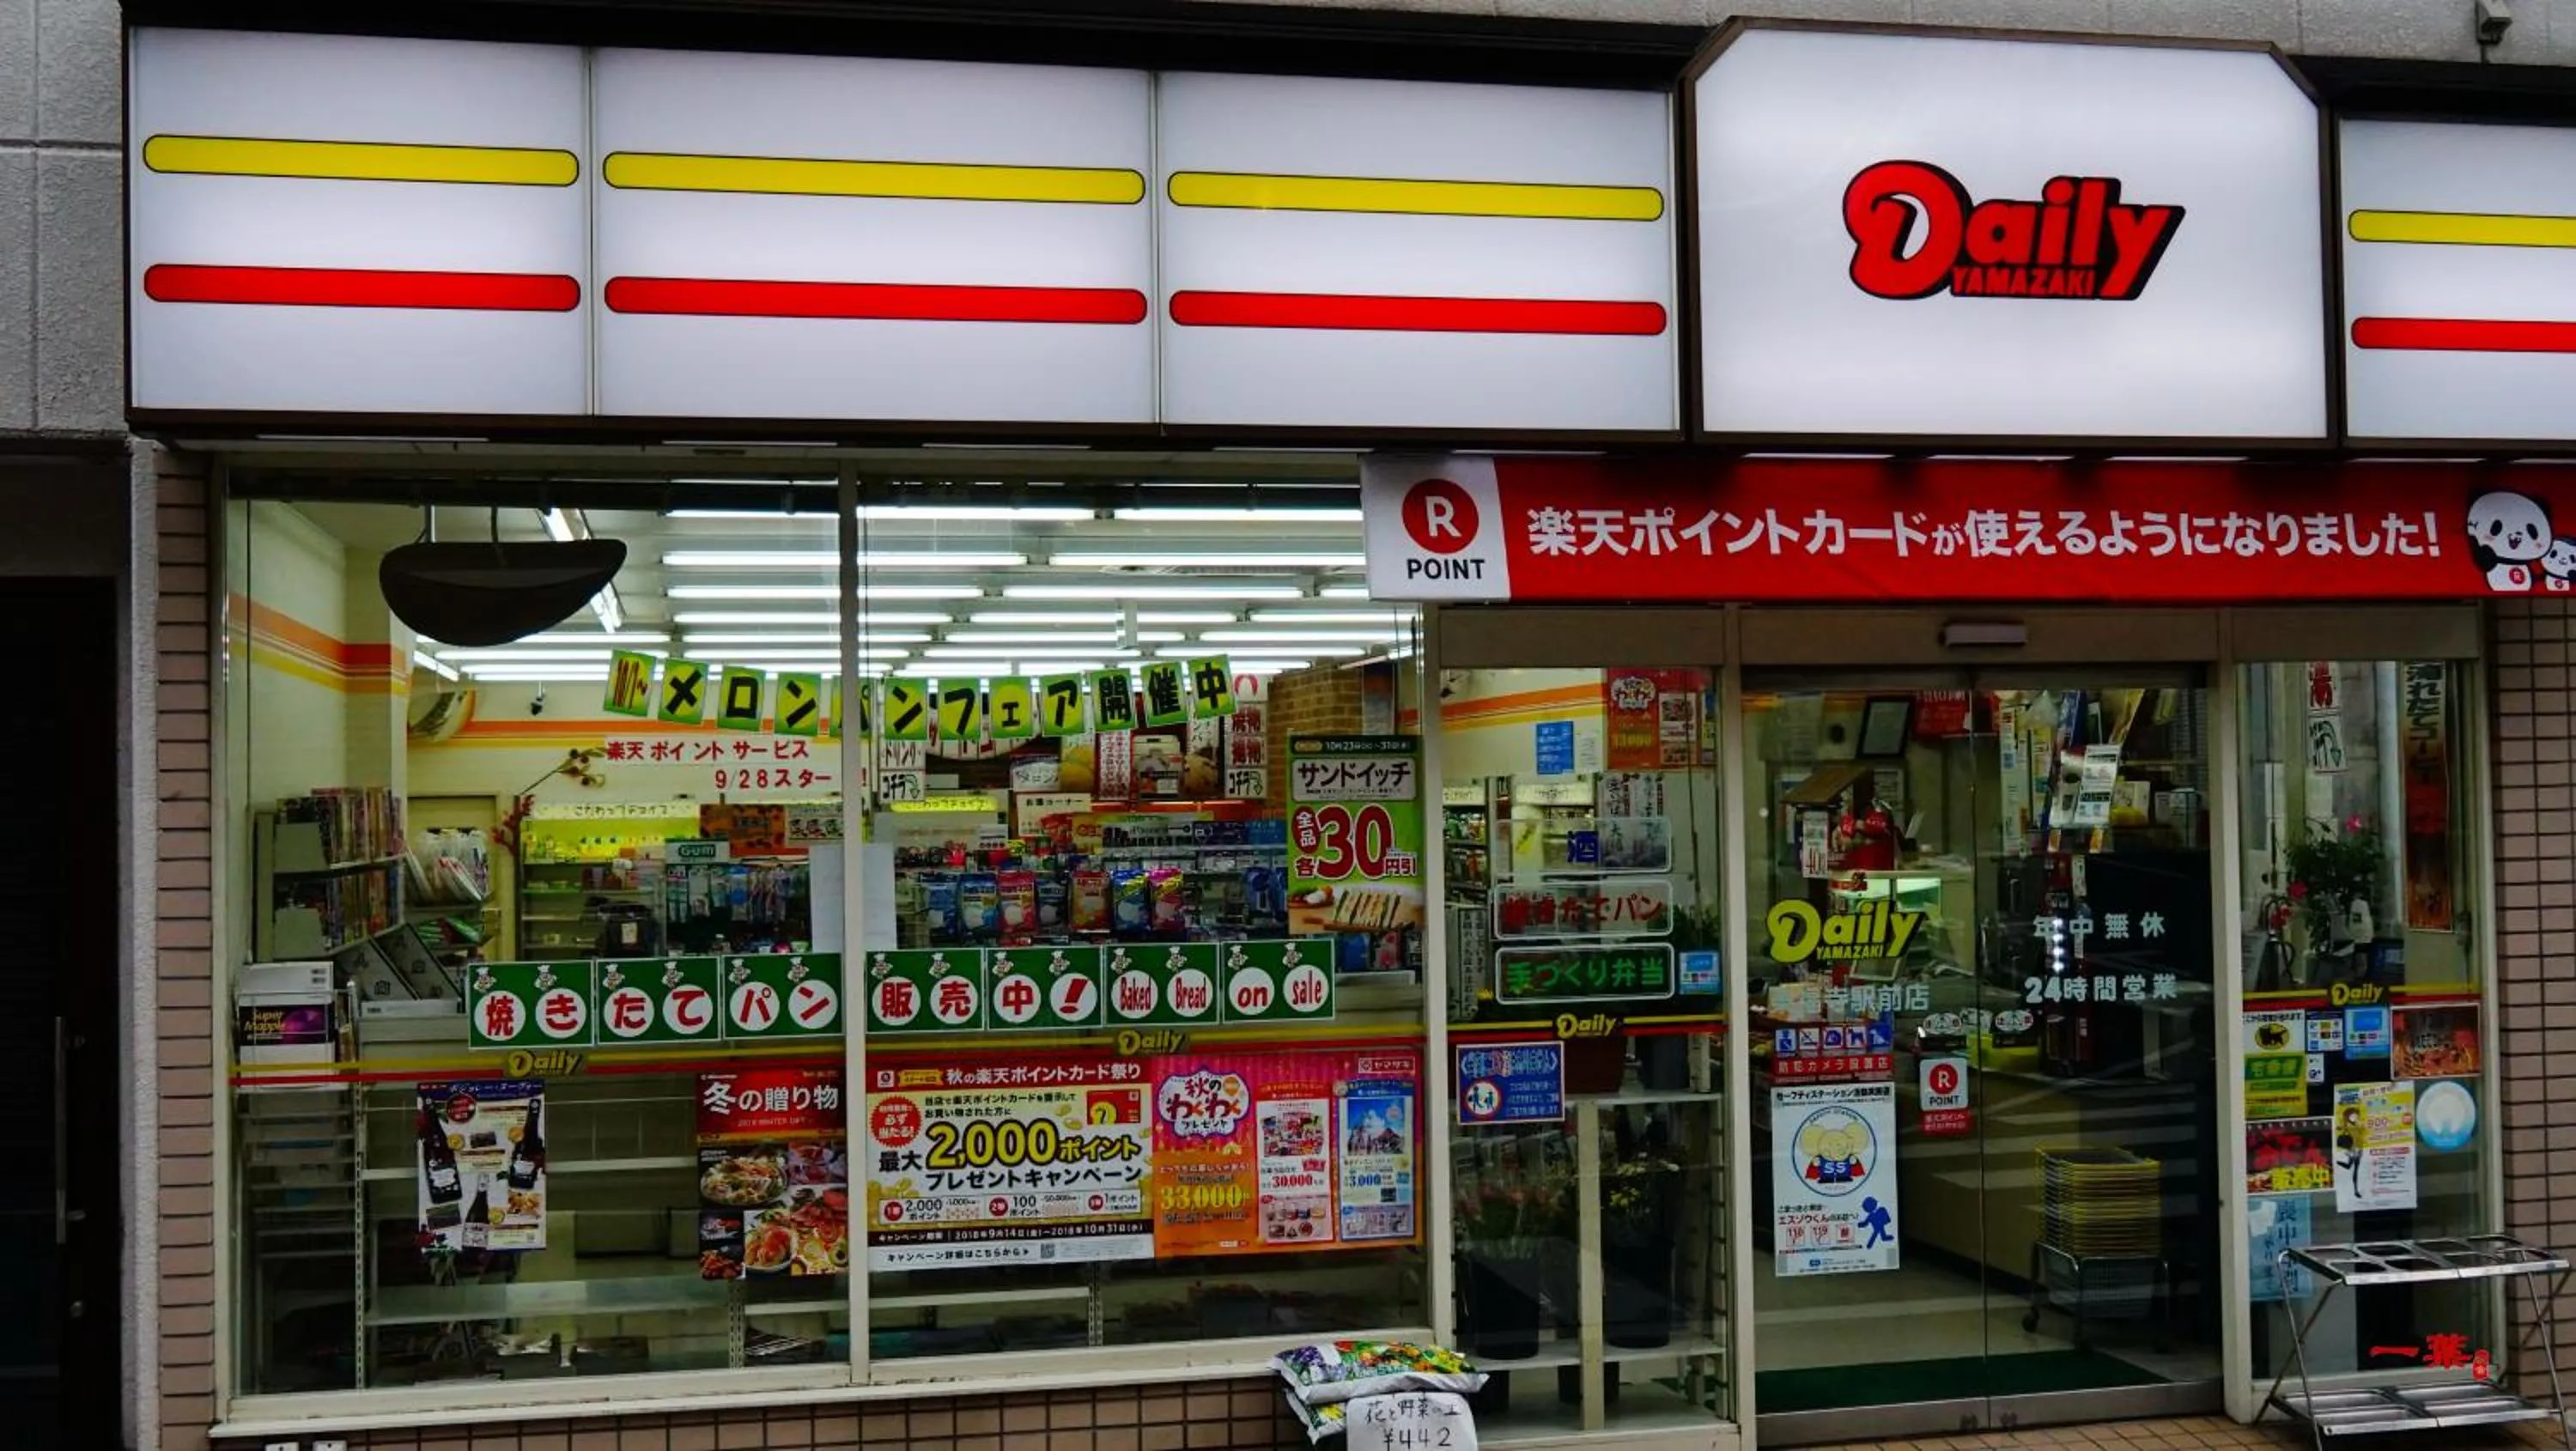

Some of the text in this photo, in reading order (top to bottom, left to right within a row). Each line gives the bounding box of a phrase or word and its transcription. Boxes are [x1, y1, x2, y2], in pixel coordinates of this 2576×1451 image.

[1843, 160, 2186, 300] Daily
[1953, 267, 2095, 296] YAMAZAKI
[1426, 495, 1461, 537] R
[1528, 507, 2441, 557] 楽天ポイントカードが使えるようになりました!
[1406, 559, 1485, 580] POINT
[714, 768, 867, 790] 9/28スター!
[1297, 762, 1411, 787] サンドイッチ
[1297, 811, 1316, 847] 全品
[1766, 898, 1924, 963] Daily
[2032, 911, 2166, 944] 年中無休
[1815, 944, 1883, 960] YAMAZAKI
[1506, 956, 1664, 994] 手づくり弁当
[1120, 975, 1322, 1011] Baked Bread on sale
[2024, 973, 2178, 1004] 24時間営業
[2330, 982, 2385, 1005] Daily
[485, 977, 1088, 1037] 焼きたてパン 販売中!
[1556, 1013, 1618, 1039] Daily
[1118, 1030, 1184, 1055] Daily
[508, 1051, 581, 1077] Daily
[945, 1064, 1141, 1085] 秋の楽天ポイントカード祭り
[1185, 1077, 1222, 1098] 秋の
[1938, 1072, 1951, 1087] R
[703, 1082, 839, 1115] 冬の贈り物
[1166, 1092, 1241, 1119] わくわく
[1929, 1095, 1960, 1106] POINT
[926, 1167, 1142, 1191] プレゼントキャンペーン
[1012, 1196, 1037, 1207] 100
